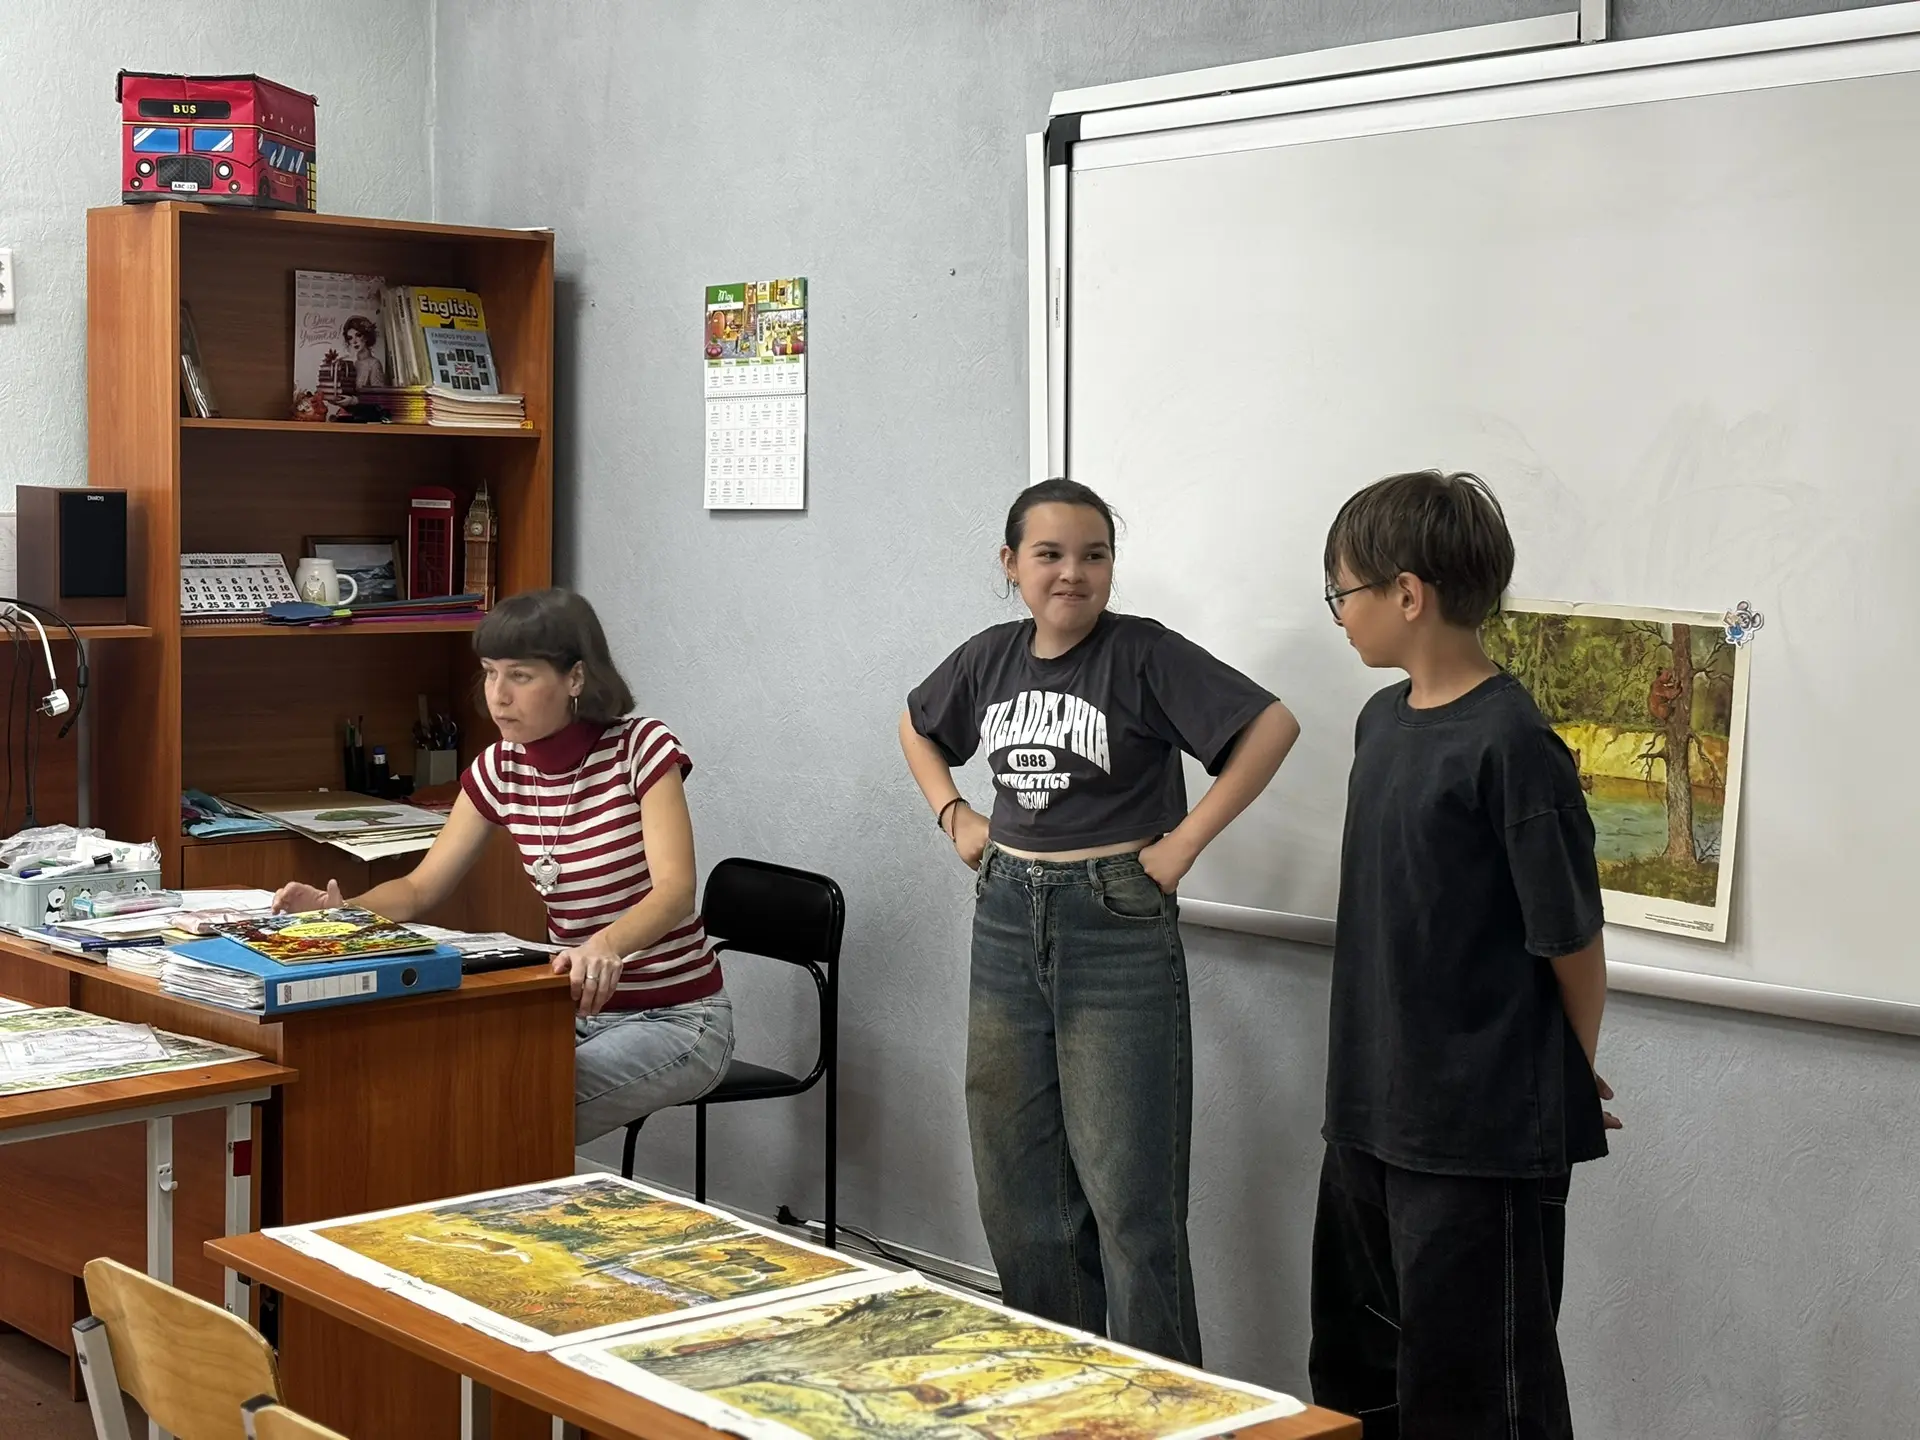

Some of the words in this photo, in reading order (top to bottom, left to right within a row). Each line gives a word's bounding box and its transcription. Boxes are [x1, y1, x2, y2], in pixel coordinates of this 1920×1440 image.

[173, 104, 197, 114] BUS
[717, 289, 734, 303] May
[418, 295, 478, 319] English
[275, 568, 282, 576] 2
[1016, 754, 1047, 767] 1988
